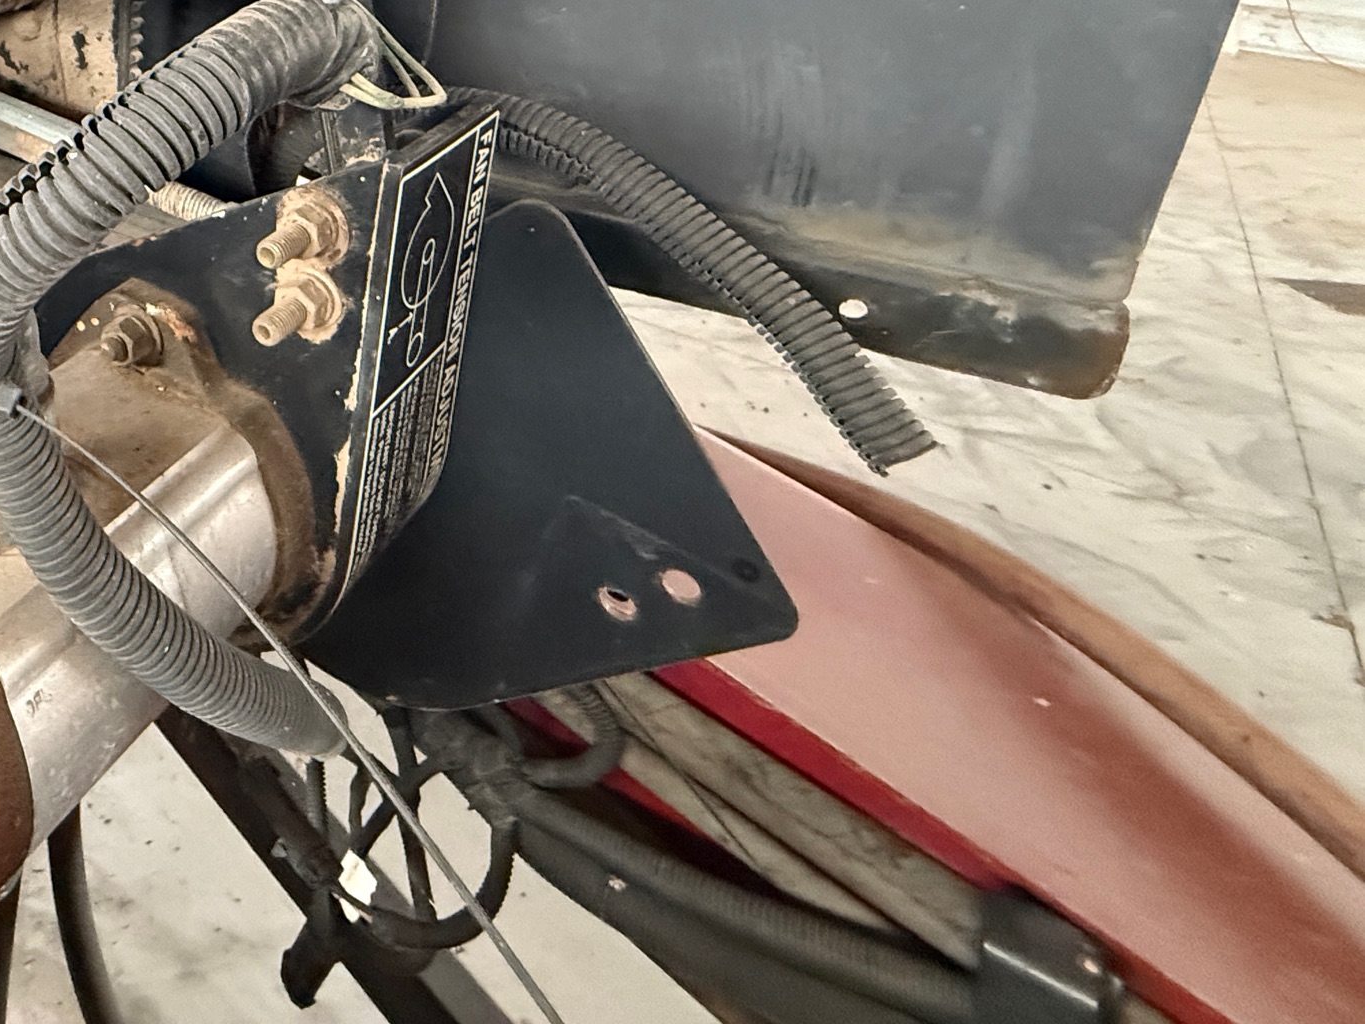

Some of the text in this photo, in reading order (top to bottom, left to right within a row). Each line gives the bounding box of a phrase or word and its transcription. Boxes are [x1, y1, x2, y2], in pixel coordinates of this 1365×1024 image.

[473, 128, 493, 185] FAN
[463, 185, 484, 250] BELT
[446, 251, 474, 362] TENSION
